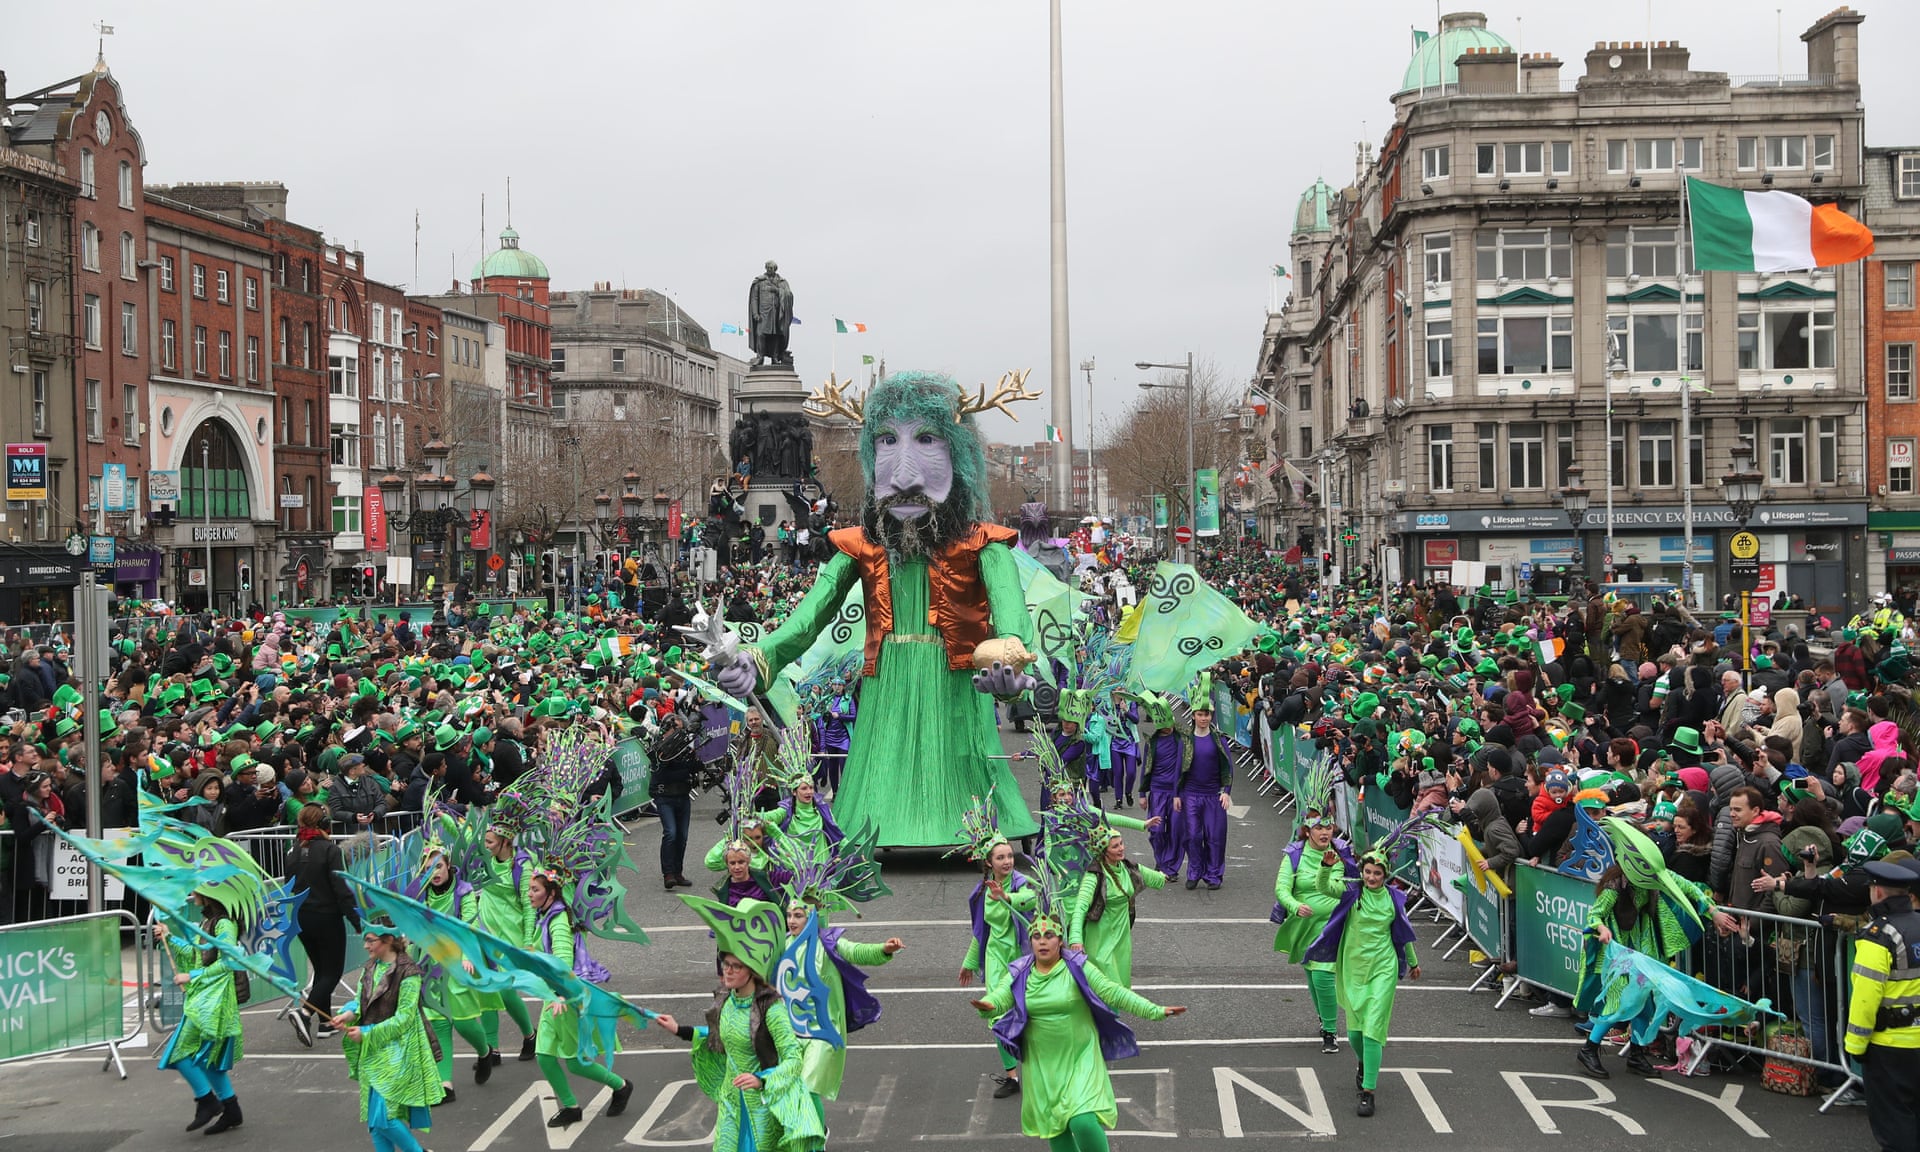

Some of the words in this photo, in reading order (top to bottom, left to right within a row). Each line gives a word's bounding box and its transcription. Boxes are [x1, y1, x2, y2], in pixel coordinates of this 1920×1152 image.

[1892, 443, 1908, 455] ID
[150, 485, 178, 498] Heaven
[1493, 516, 1525, 525] Lifespan
[1772, 512, 1805, 520] Lifespan
[222, 528, 238, 540] KING
[121, 558, 151, 567] PHARMACY
